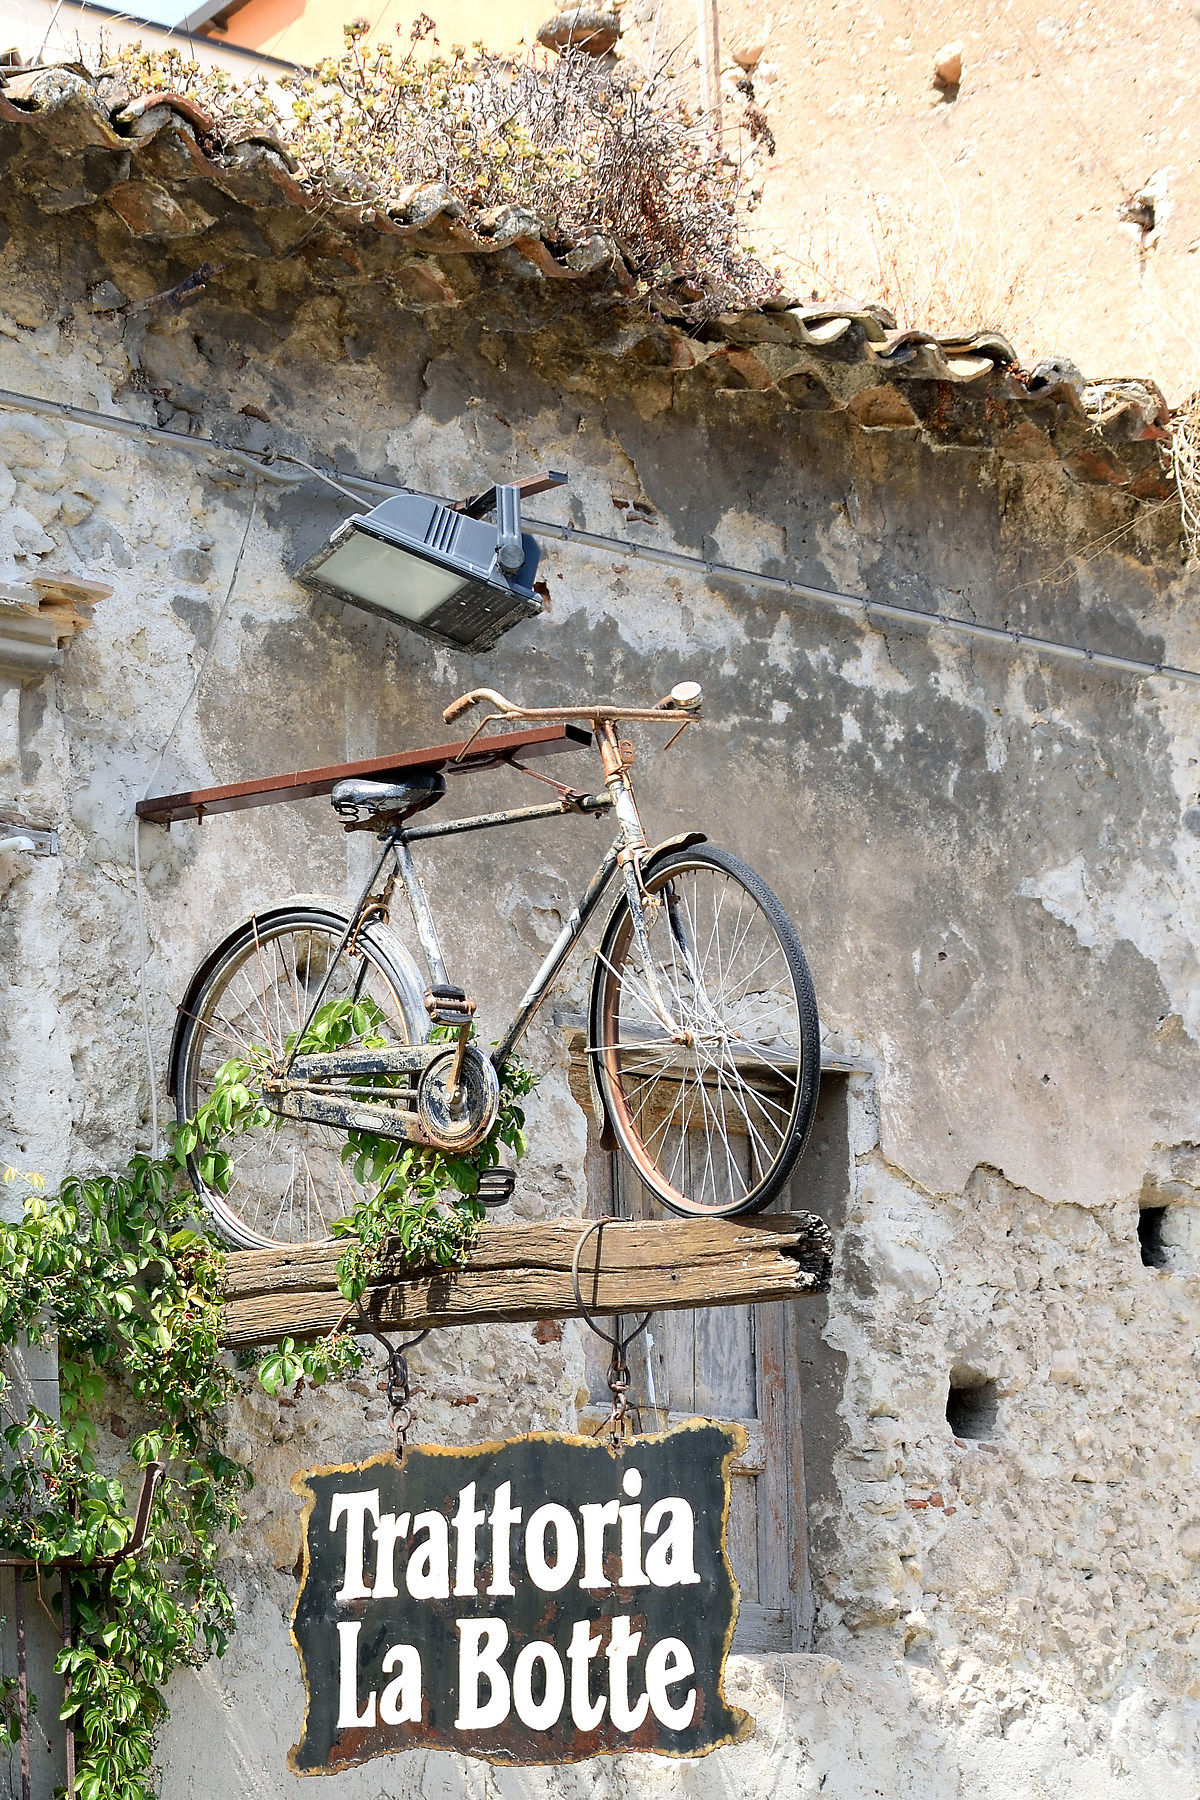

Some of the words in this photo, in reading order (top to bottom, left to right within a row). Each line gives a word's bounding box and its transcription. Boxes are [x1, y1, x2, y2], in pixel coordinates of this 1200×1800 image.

[329, 1467, 701, 1601] Trattoria
[335, 1620, 423, 1729] La
[453, 1615, 697, 1732] Botte
